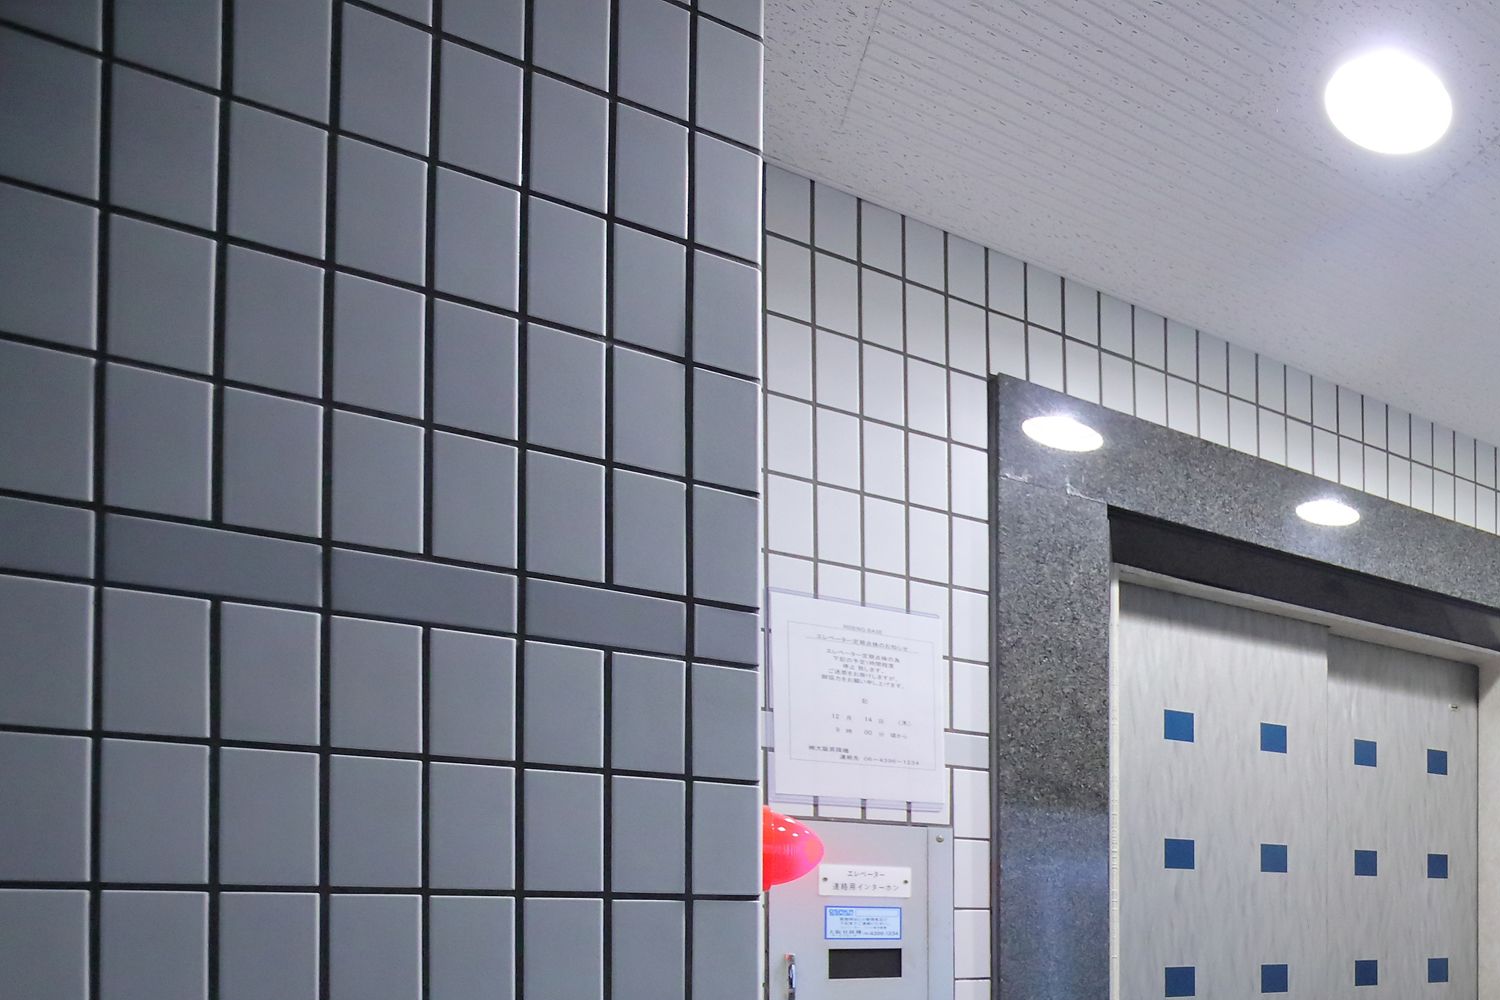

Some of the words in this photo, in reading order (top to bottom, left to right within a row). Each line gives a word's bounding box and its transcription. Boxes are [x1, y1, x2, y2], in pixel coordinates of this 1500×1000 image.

[847, 870, 885, 878] エレベーター
